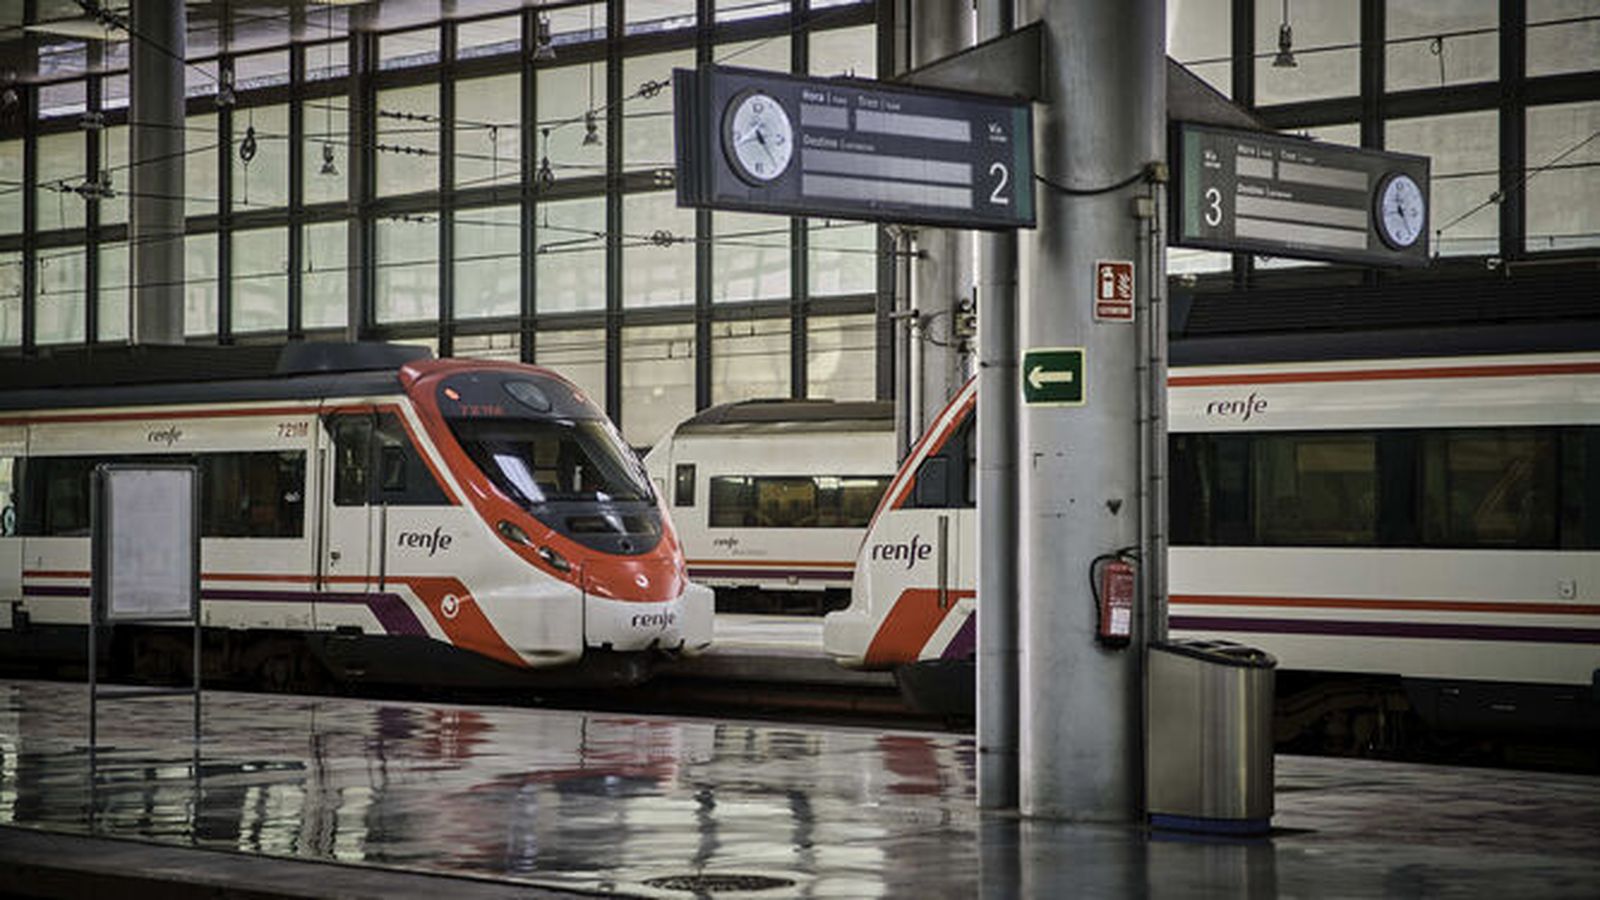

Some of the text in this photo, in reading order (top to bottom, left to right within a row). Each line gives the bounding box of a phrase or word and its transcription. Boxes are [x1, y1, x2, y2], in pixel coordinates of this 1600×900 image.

[989, 162, 1010, 205] 2
[1205, 187, 1222, 227] 3
[1207, 392, 1268, 423] renfe
[148, 425, 183, 448] renfe
[398, 526, 452, 557] renfe
[872, 533, 933, 570] renfe
[631, 607, 677, 631] renfe
